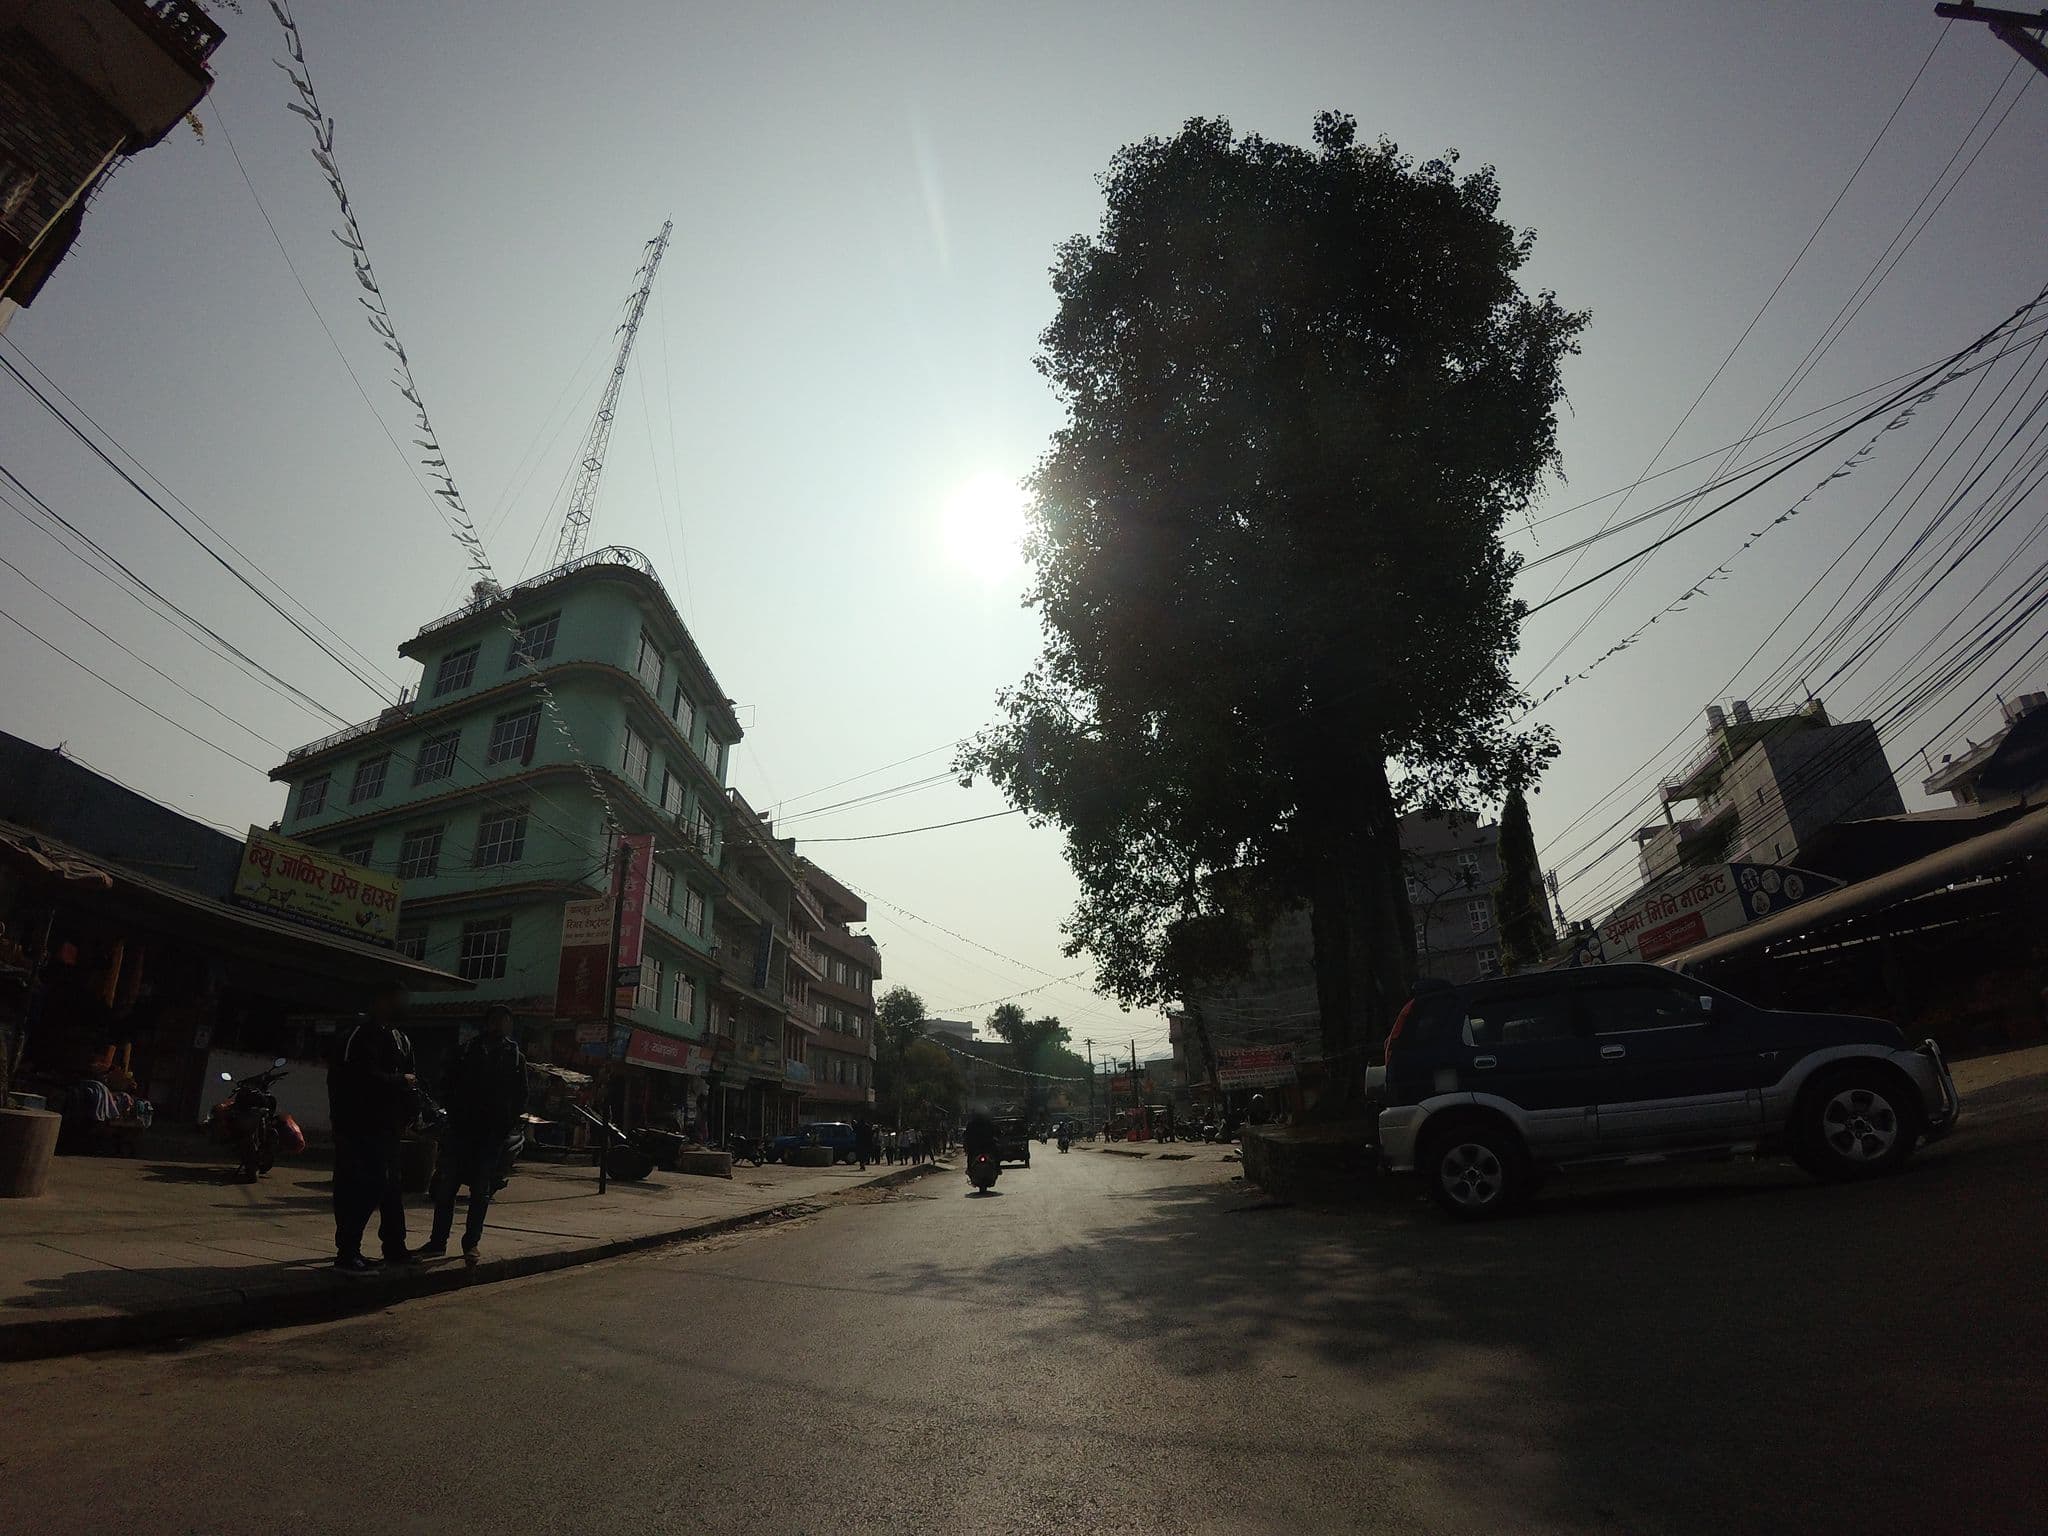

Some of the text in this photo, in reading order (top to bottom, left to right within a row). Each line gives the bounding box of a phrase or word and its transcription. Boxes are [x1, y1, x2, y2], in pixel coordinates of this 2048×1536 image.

[277, 854, 330, 889] जाकिर
[361, 883, 398, 912] हाउस
[1646, 893, 1679, 923] मिनि
